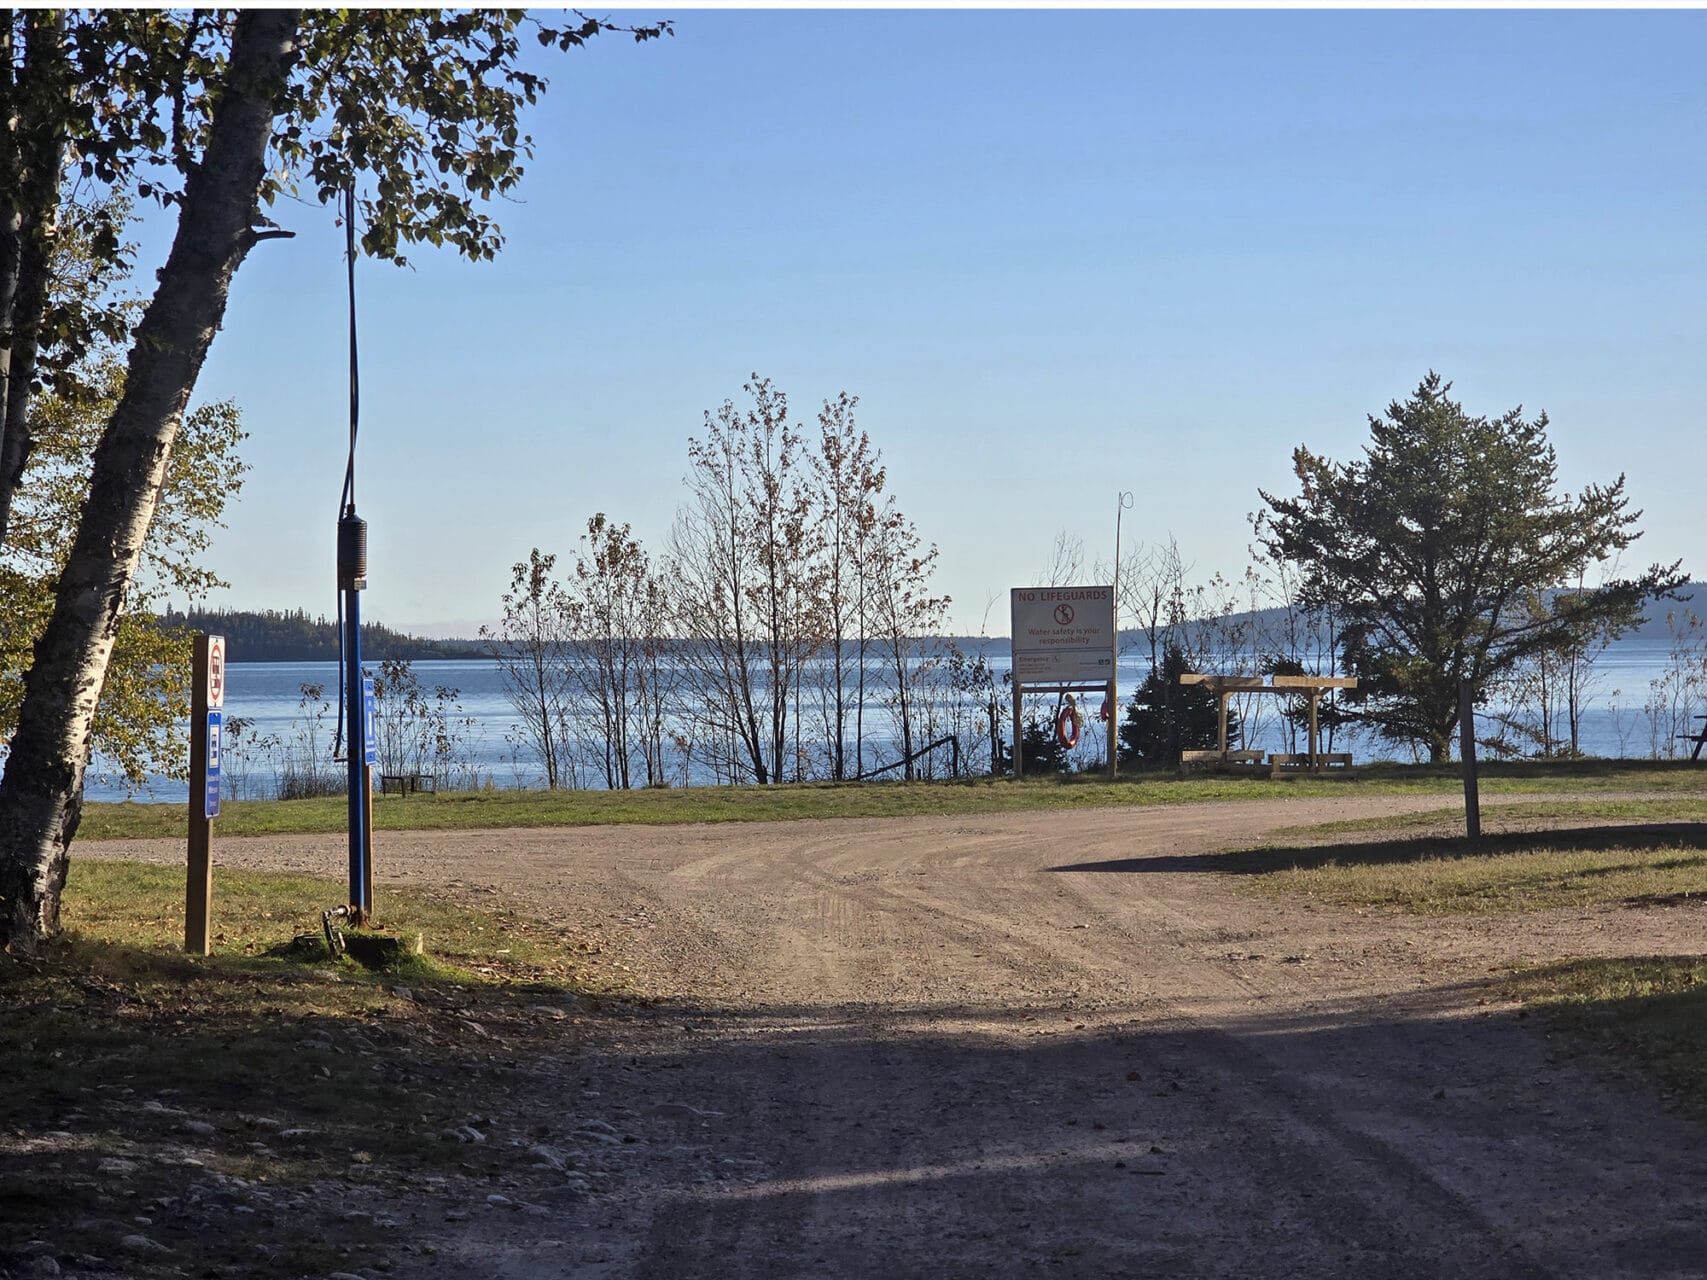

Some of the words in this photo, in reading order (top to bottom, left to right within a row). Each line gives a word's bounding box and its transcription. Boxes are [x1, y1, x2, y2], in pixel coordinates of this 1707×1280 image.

[1018, 592, 1035, 602] NO
[1041, 590, 1107, 602] LIFEGUARDS
[1028, 628, 1050, 636] Water
[1052, 628, 1074, 636] safety
[1076, 627, 1082, 635] is
[1084, 627, 1100, 636] your
[1039, 636, 1090, 645] responsibility
